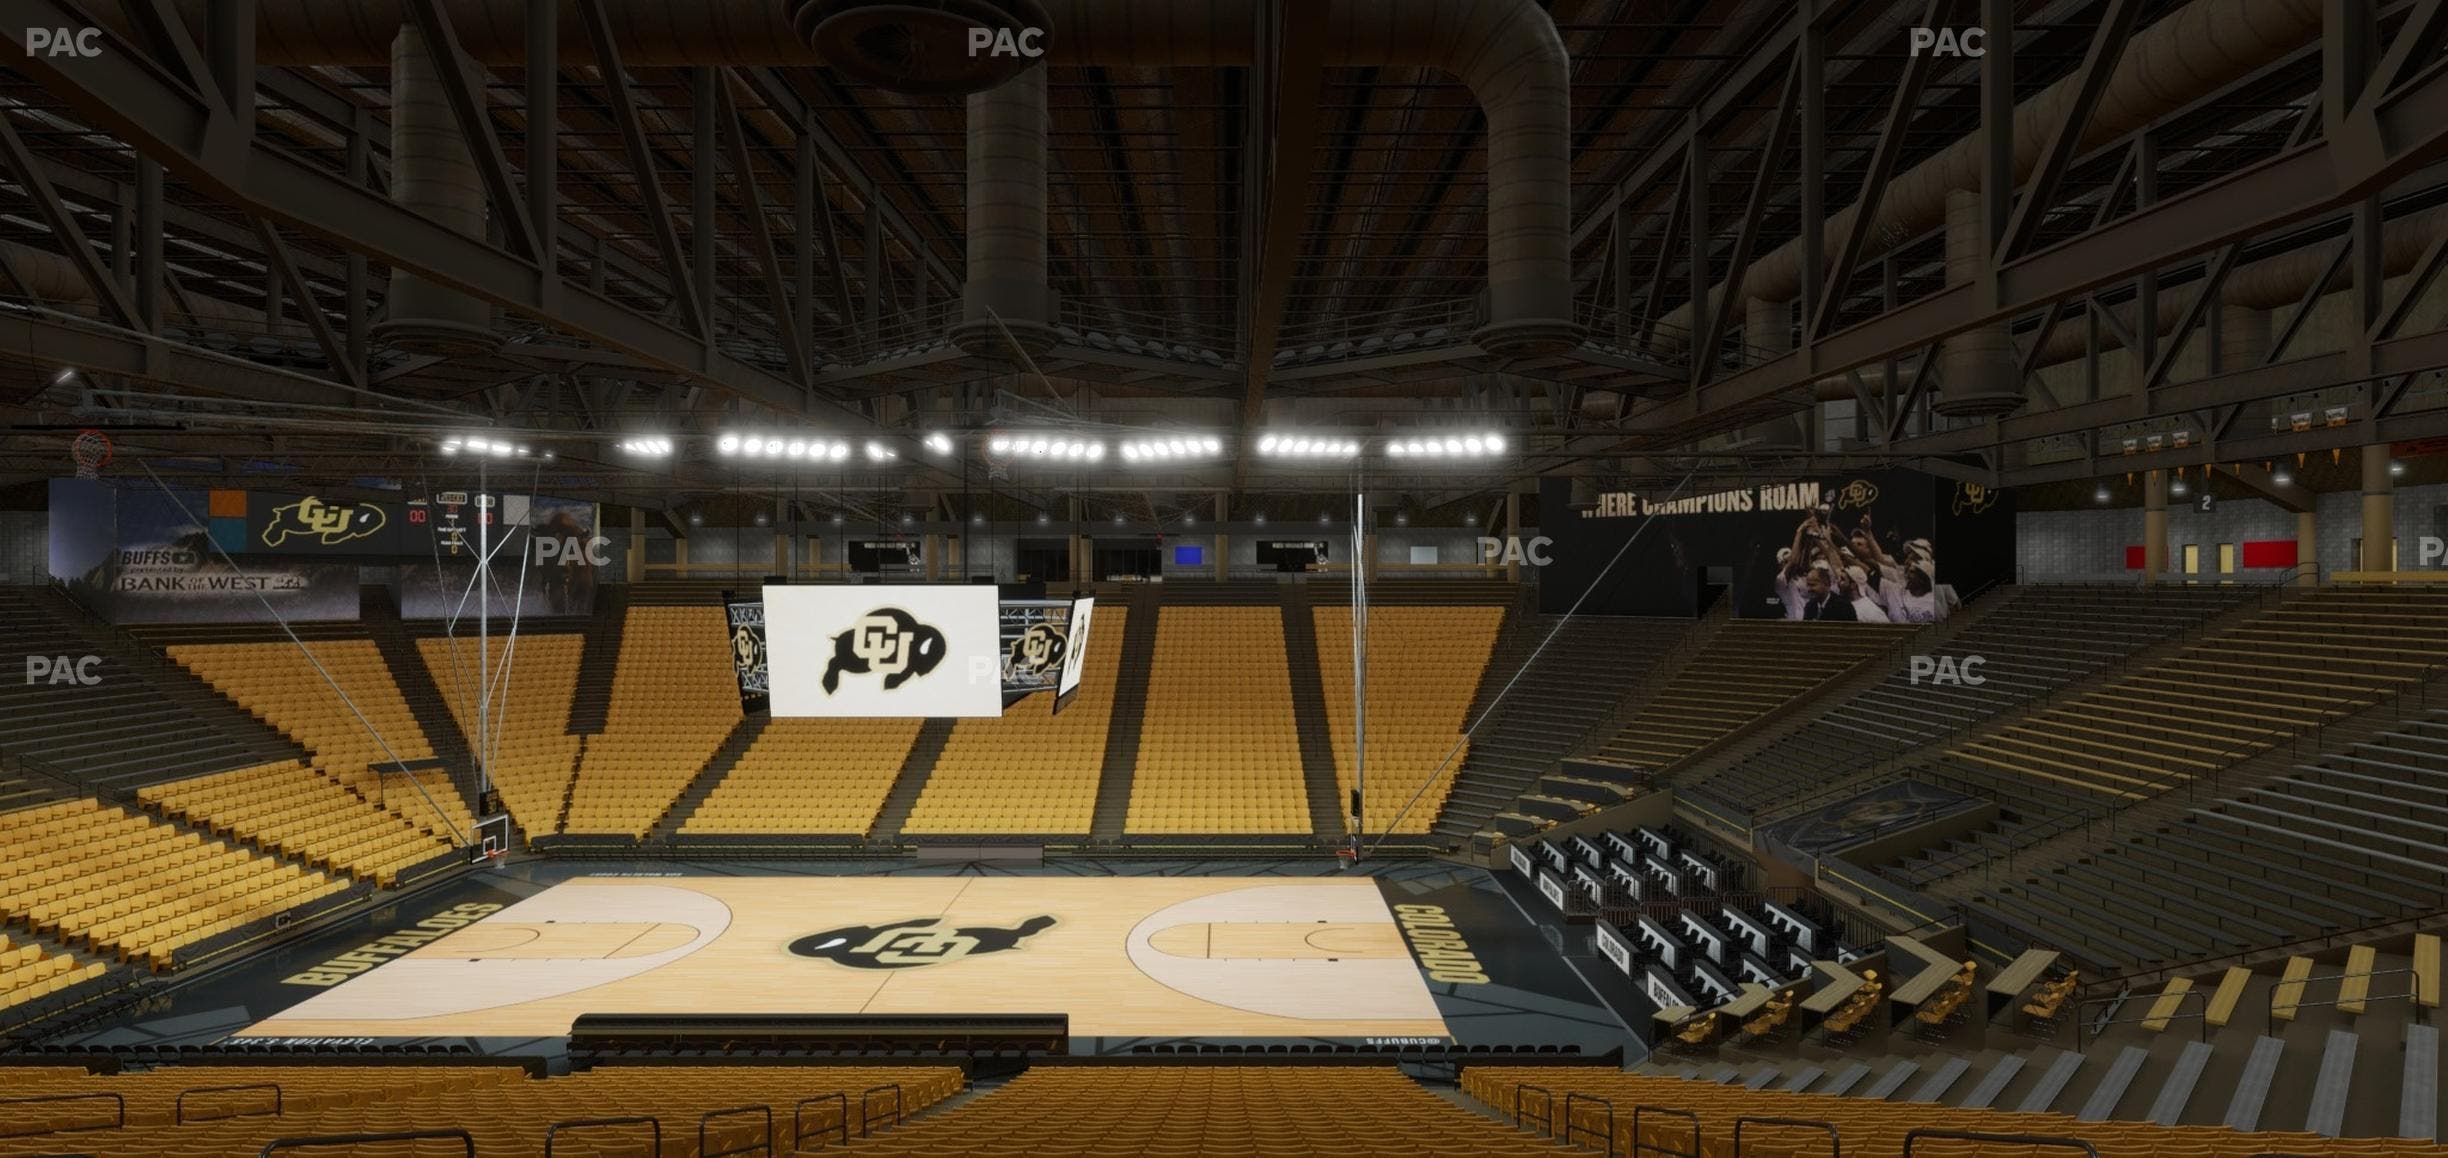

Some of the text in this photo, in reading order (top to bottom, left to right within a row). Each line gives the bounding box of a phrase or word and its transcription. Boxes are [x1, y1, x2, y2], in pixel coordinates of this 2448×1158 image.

[297, 495, 354, 533] CU
[1582, 493, 1637, 518] HERE
[2201, 494, 2212, 511] 2
[121, 551, 170, 565] BUFFS
[120, 576, 186, 592] BANK
[208, 576, 271, 590] WEST
[853, 614, 914, 674] CU
[1023, 630, 1053, 665] CU
[280, 902, 504, 987] BUFFALOES
[1393, 904, 1491, 984] COLORADO
